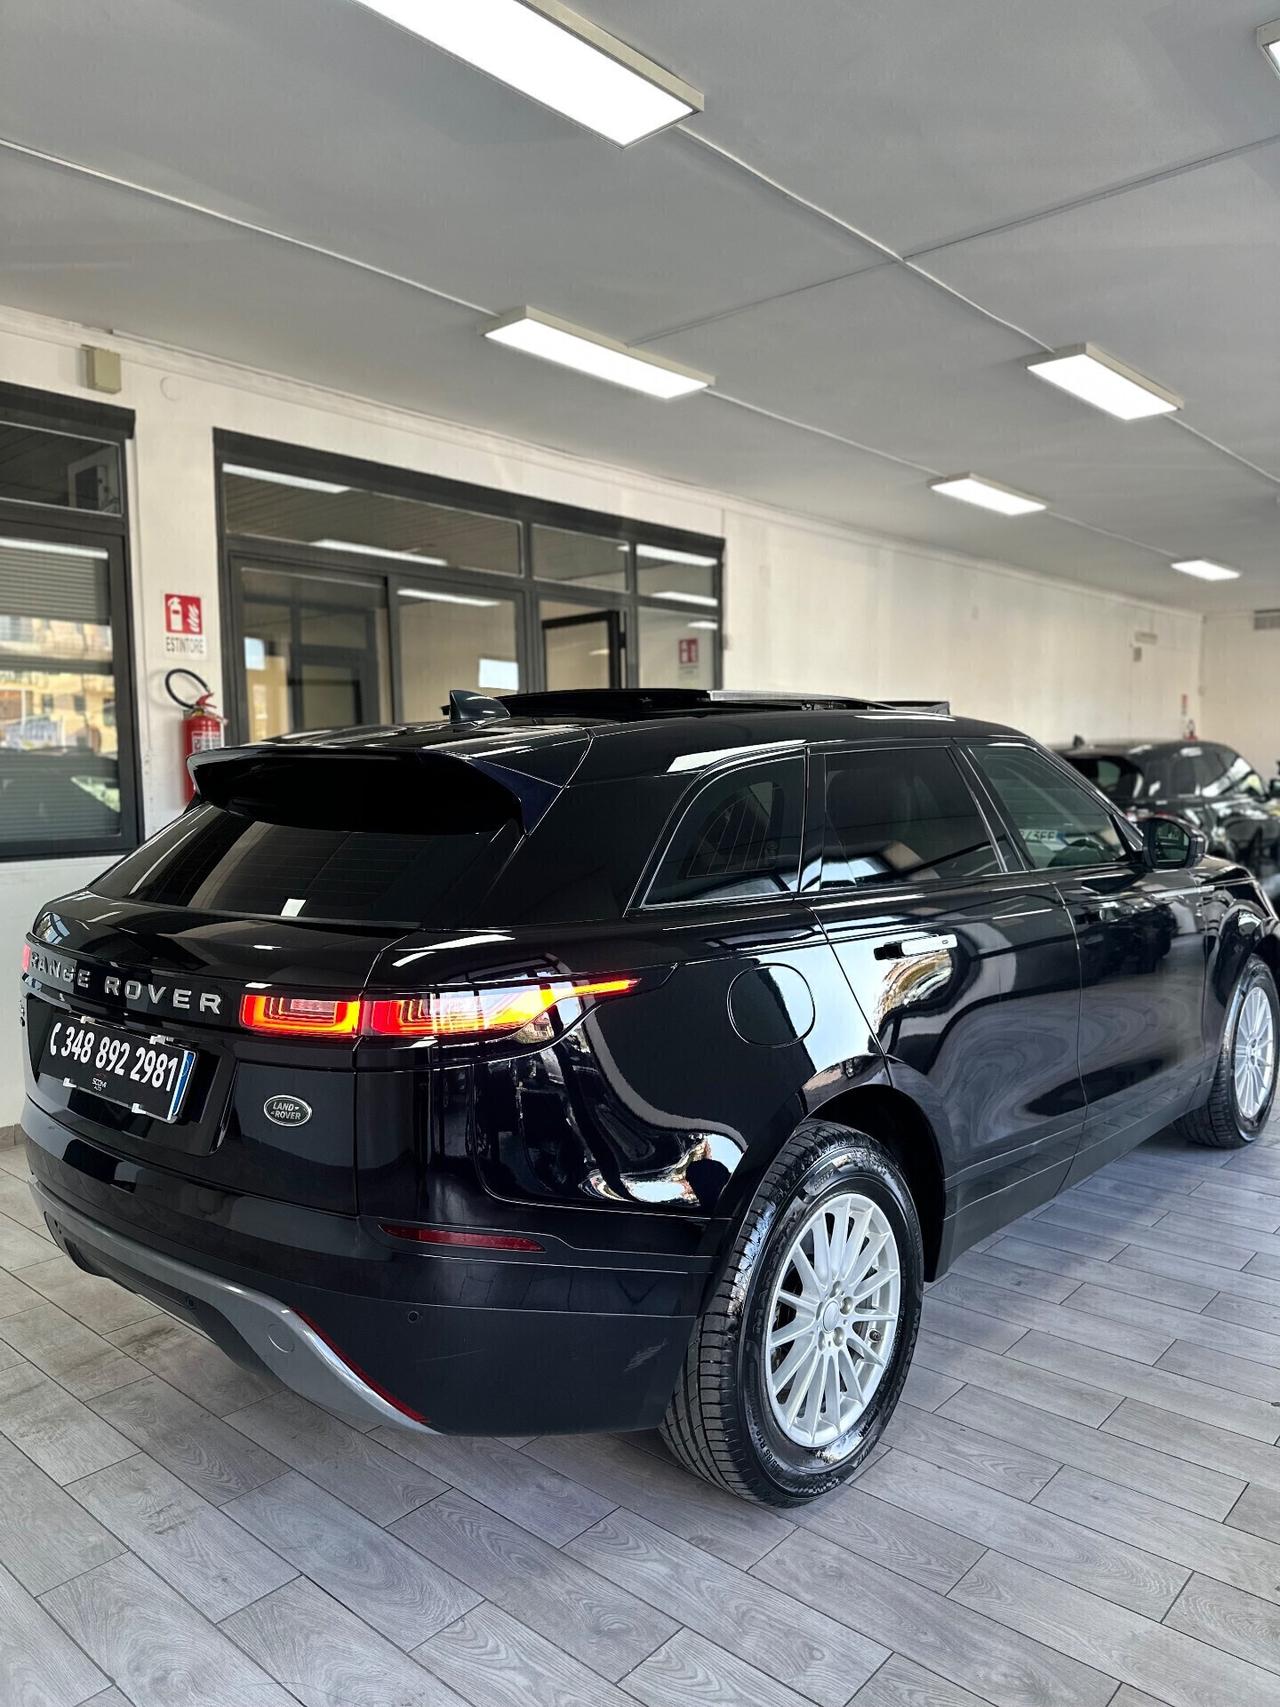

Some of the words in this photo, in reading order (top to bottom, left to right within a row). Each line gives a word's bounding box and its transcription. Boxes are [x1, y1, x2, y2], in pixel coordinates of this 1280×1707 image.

[166, 636, 204, 654] ESTINTORE
[31, 951, 90, 988] RANGE
[104, 976, 221, 1015] ROVER
[61, 1026, 95, 1064] 348
[95, 1036, 130, 1076] 892
[130, 1047, 179, 1092] 2981
[273, 1101, 295, 1111] LAND
[275, 1110, 301, 1120] ROVER
